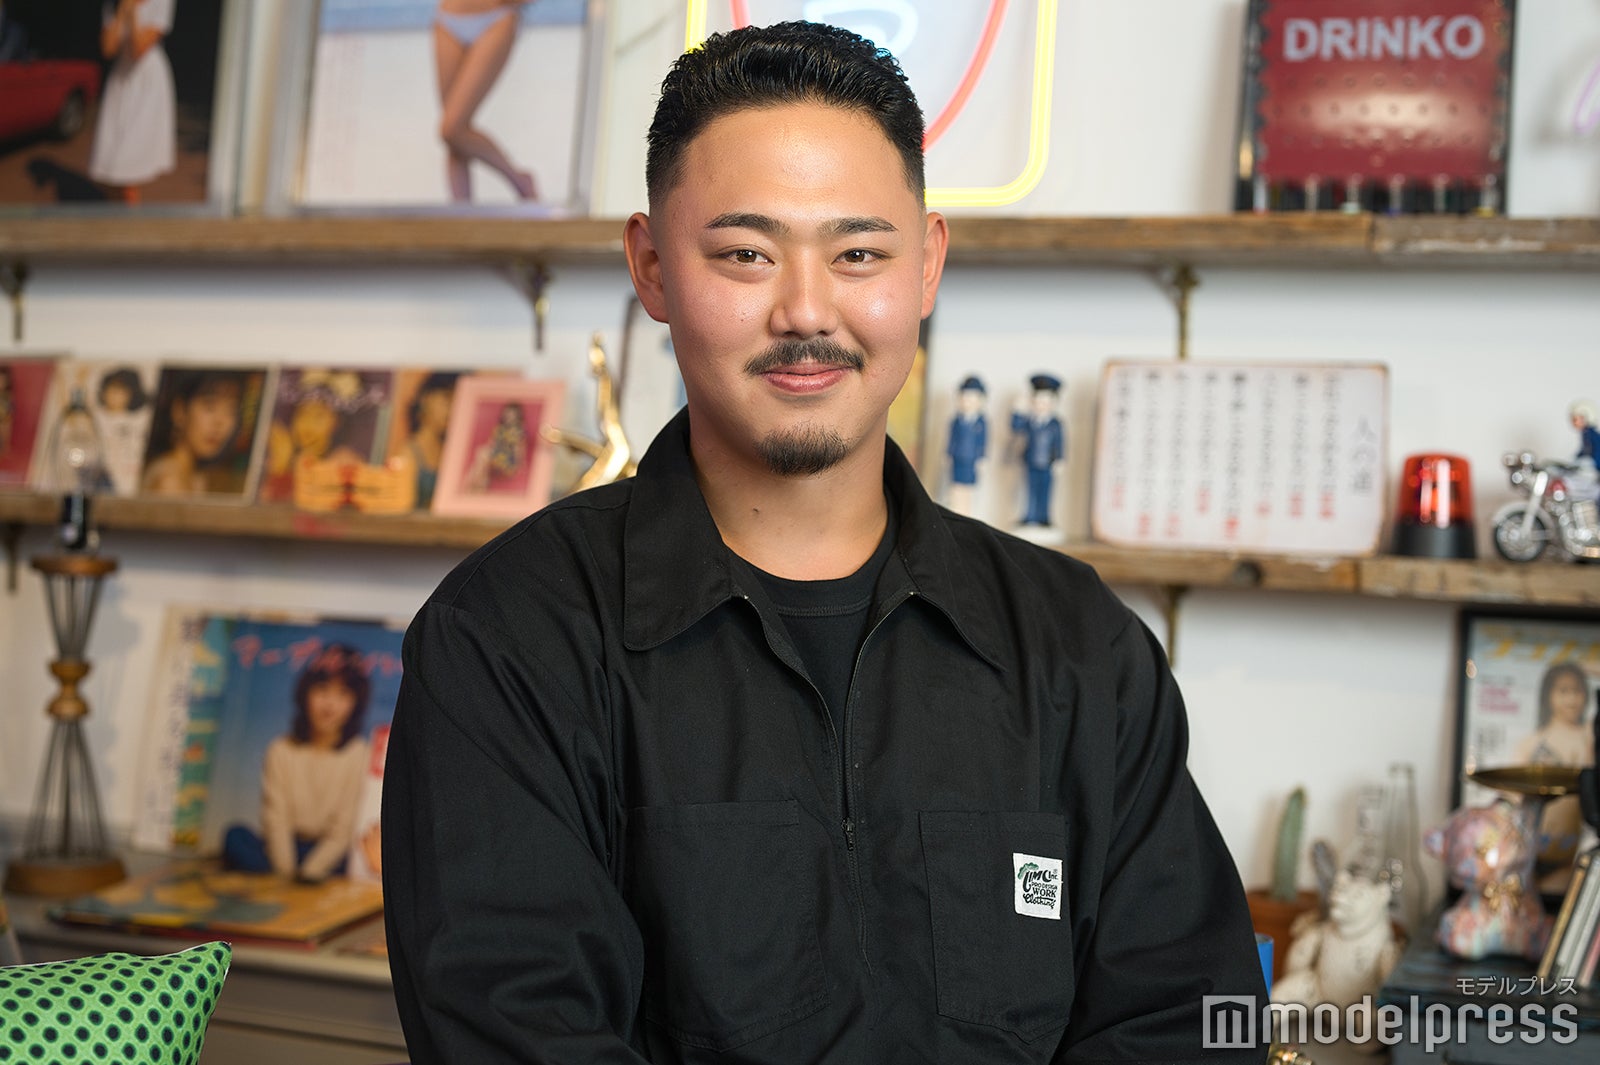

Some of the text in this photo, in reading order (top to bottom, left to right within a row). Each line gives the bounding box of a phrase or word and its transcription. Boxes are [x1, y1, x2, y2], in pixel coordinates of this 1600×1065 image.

[1283, 14, 1485, 62] DRINKO
[1033, 887, 1056, 898] WORK
[1023, 893, 1056, 909] Clothing
